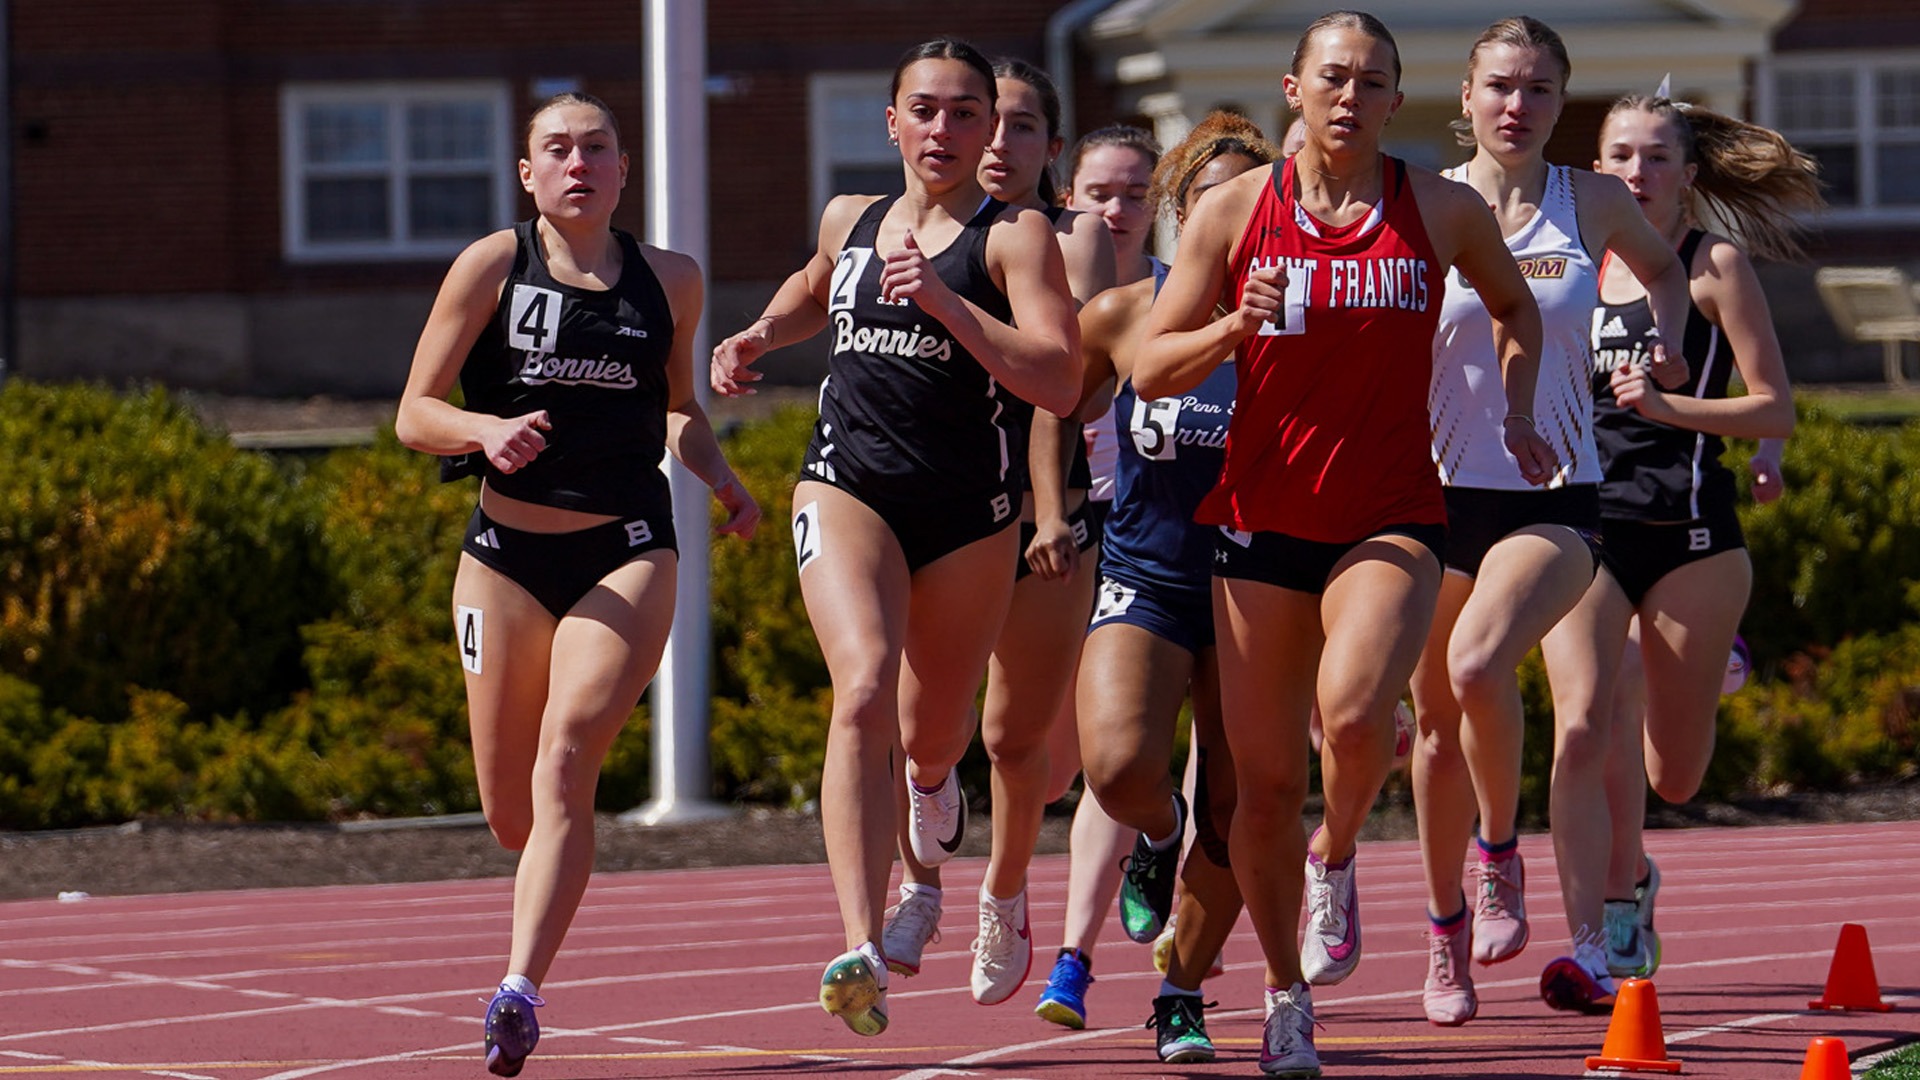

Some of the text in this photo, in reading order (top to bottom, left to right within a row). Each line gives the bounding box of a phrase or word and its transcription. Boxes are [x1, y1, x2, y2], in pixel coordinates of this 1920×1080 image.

[831, 250, 858, 306] 2
[1328, 257, 1428, 313] FRANCIS
[516, 292, 549, 349] 4
[832, 311, 952, 362] Bonnies
[519, 350, 638, 389] Bonnies
[1141, 400, 1170, 456] 5
[1181, 395, 1222, 414] Penn
[624, 519, 653, 547] B
[990, 492, 1011, 523] B
[795, 511, 813, 569] 2
[1688, 527, 1711, 550] B
[464, 613, 477, 669] 4
